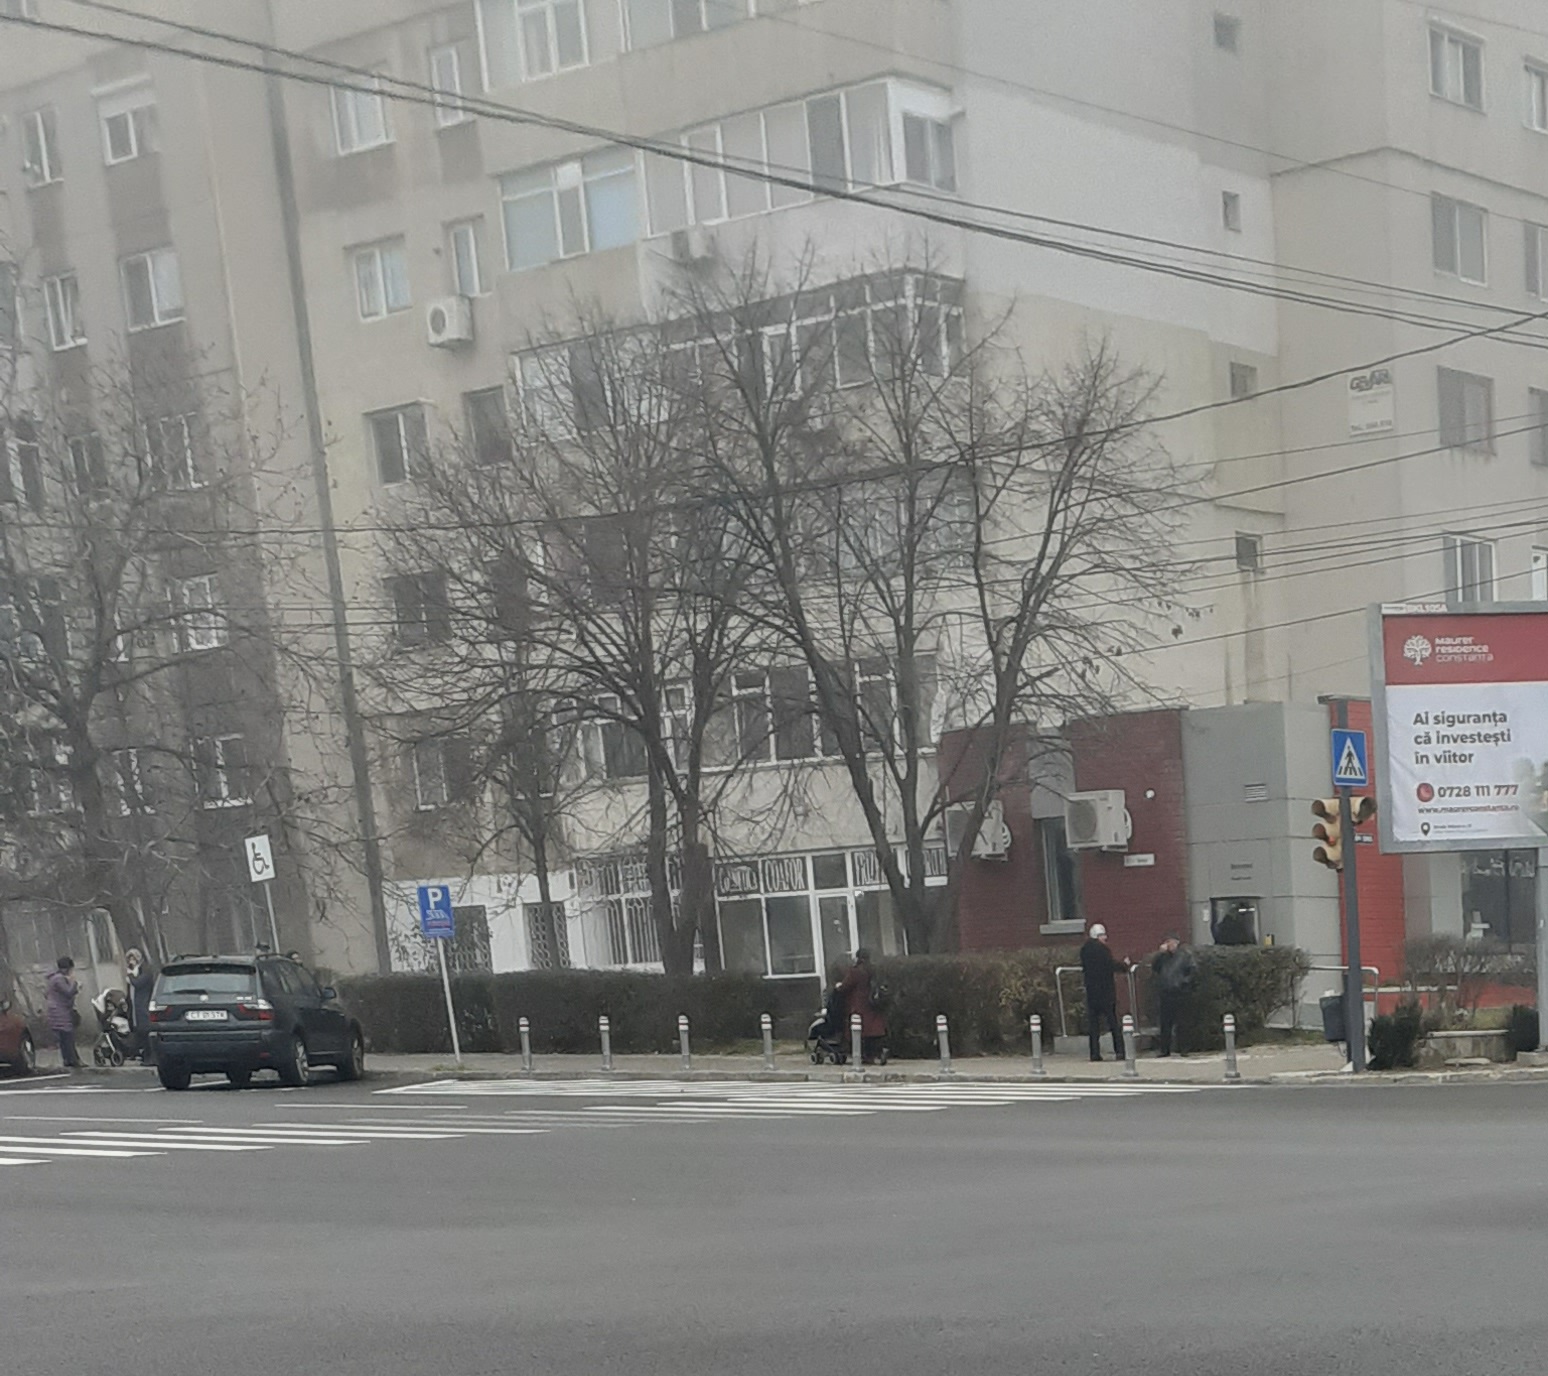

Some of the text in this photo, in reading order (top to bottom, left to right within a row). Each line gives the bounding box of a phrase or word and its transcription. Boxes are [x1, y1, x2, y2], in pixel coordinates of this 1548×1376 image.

[1433, 710, 1508, 728] siguranța
[1413, 731, 1432, 745] că
[1433, 749, 1475, 764] viitor
[1437, 784, 1519, 798] 0728 111 777
[427, 888, 443, 910] P
